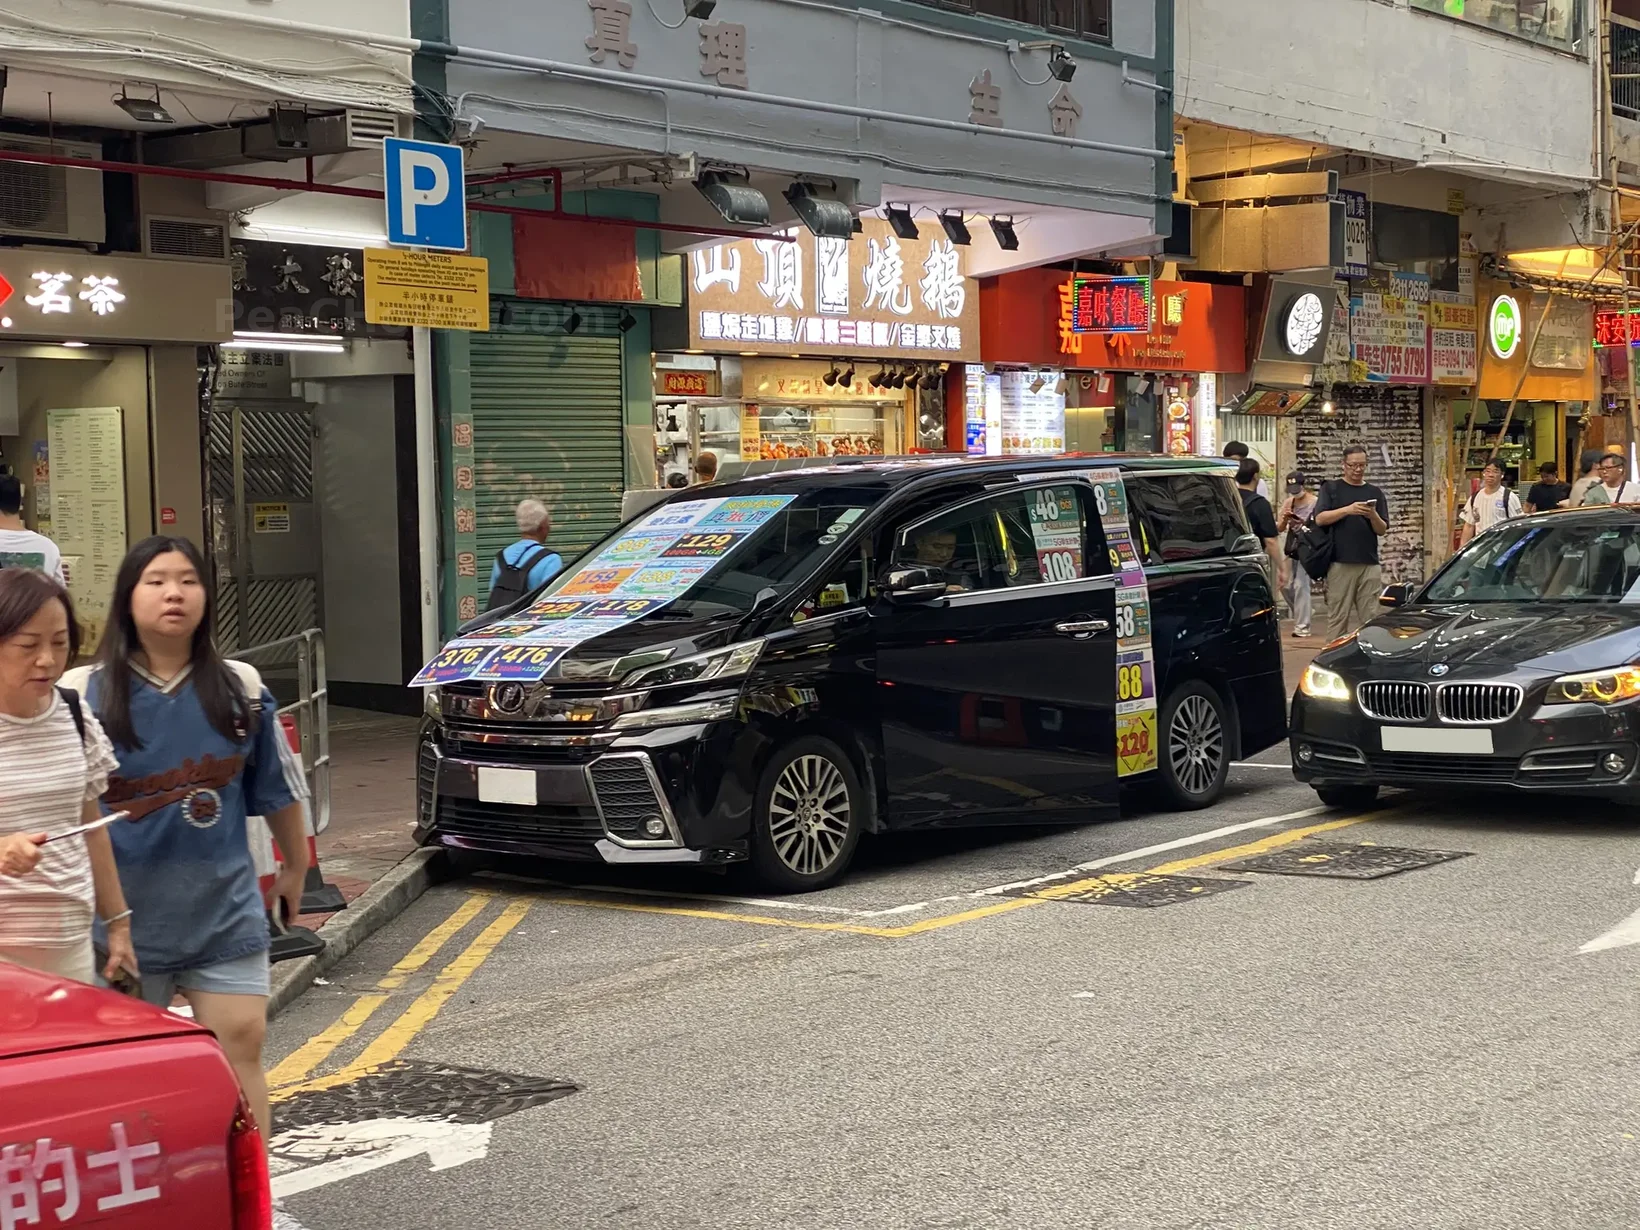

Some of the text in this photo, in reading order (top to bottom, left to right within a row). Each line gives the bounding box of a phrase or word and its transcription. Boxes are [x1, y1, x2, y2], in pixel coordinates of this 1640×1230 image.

[399, 150, 451, 236] P
[1077, 285, 1145, 328] 嘉味餐廳
[1118, 663, 1144, 701] 88
[0, 1122, 161, 1230] 的士
